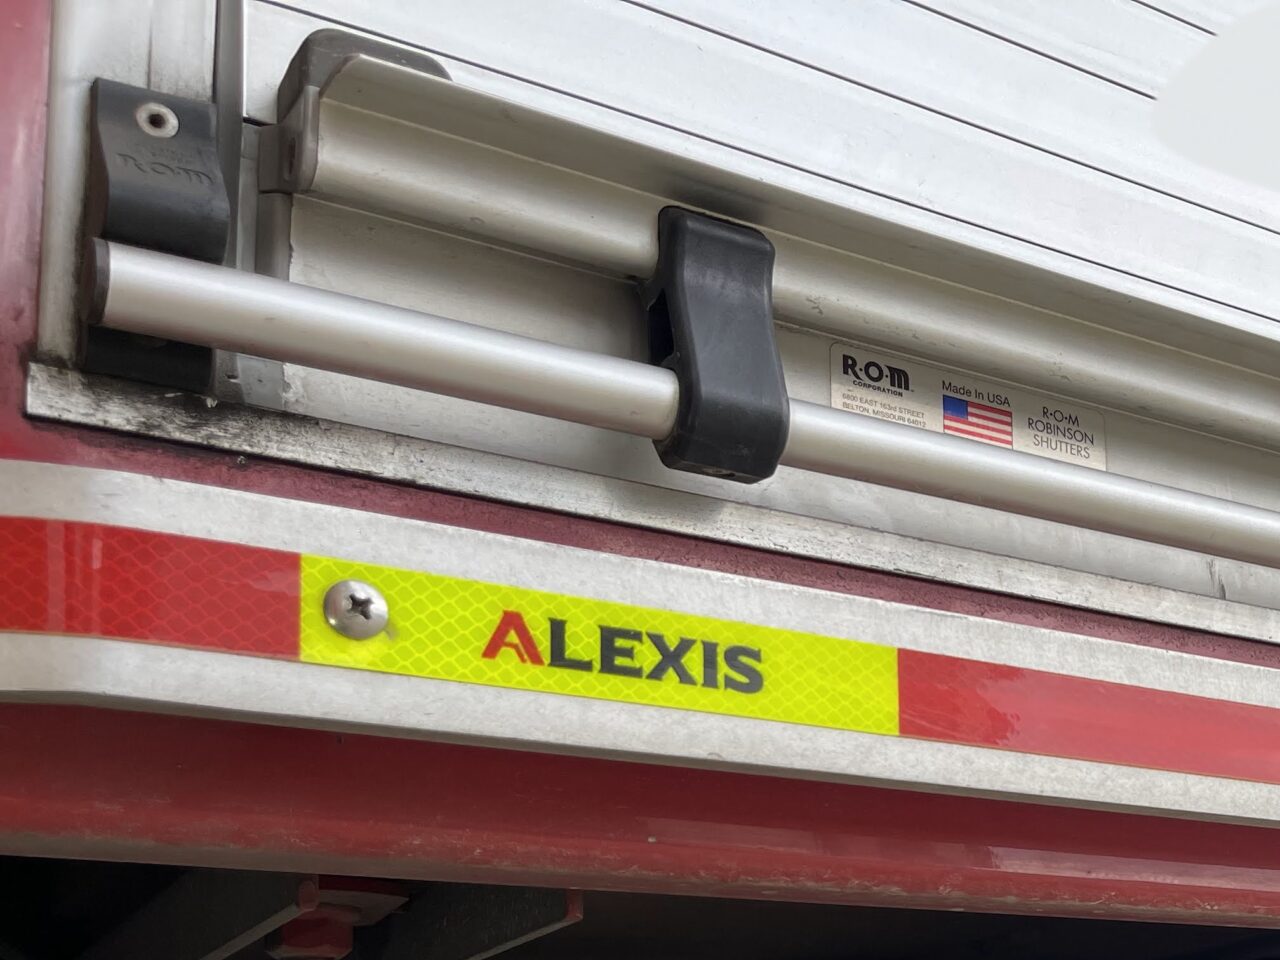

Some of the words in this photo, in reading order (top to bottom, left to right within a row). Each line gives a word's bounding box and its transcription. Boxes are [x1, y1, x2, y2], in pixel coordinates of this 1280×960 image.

[852, 380, 903, 397] CORPORATION
[942, 380, 972, 397] Made
[975, 389, 985, 401] In
[987, 392, 1011, 407] USA
[860, 397, 878, 407] EAST
[898, 405, 926, 419] STREET
[872, 409, 906, 423] MISSOURI
[1027, 417, 1095, 446] ROBINSON
[1033, 433, 1090, 459] SHUTTERS
[481, 610, 764, 694] ALEXIS
